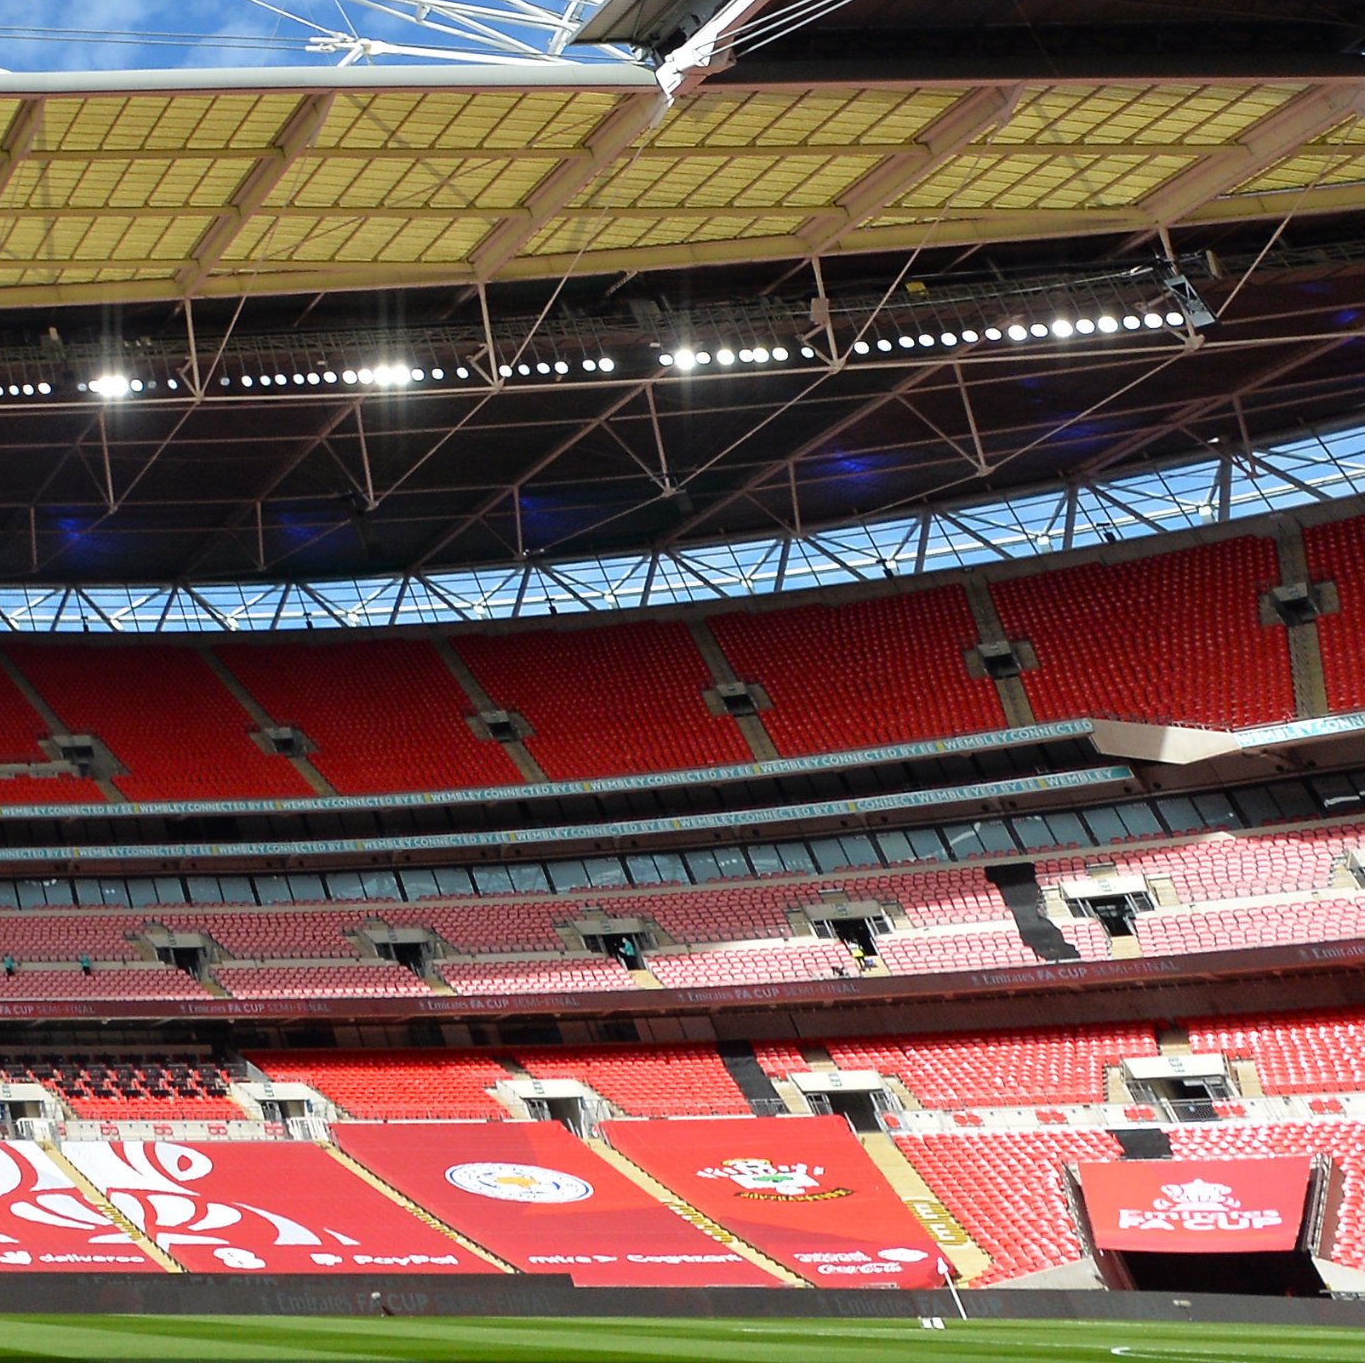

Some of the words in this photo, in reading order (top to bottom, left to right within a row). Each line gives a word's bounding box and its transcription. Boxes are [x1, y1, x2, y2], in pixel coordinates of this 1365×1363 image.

[944, 733, 1006, 751] WEMBLEY
[1011, 721, 1091, 742] CONNECTED
[761, 757, 819, 774] WEMBLEY
[822, 748, 895, 767] CONNECTED
[901, 745, 916, 757] BY
[920, 743, 934, 754] EE
[591, 776, 644, 791] WEMBLEY
[647, 769, 716, 785] CONNECTED
[719, 767, 733, 778] BY
[739, 765, 750, 776] EE
[1049, 770, 1111, 788] WEMBLEY
[431, 790, 482, 803] WEMBLEY
[484, 785, 549, 799] CONNECTED
[552, 783, 565, 794] BY
[569, 782, 582, 792] EE
[857, 795, 917, 811] CONNECT
[1002, 782, 1018, 794] BY
[1022, 780, 1035, 792] EE
[681, 814, 735, 829] WEMBLEY
[739, 806, 809, 823] CONNECTED
[815, 804, 832, 816] BY
[835, 803, 846, 814] EE
[983, 971, 1034, 985] Emirates
[1036, 969, 1053, 981] FA
[1058, 967, 1087, 980] CUP
[427, 999, 468, 1009] Emirates
[469, 999, 483, 1009] FA
[486, 998, 509, 1008] CUP
[512, 997, 581, 1008] SEMI-FINAL
[687, 990, 733, 1002] Emirates
[735, 989, 749, 1000] FA
[753, 987, 779, 999] CUP
[0, 1005, 11, 1014] FA
[13, 1005, 34, 1014] CUP
[187, 1003, 226, 1013] Emirates
[227, 1003, 241, 1013] FA
[243, 1003, 265, 1013] CUP
[1118, 1209, 1282, 1220] Emirates
[1118, 1217, 1175, 1231] FA
[1181, 1217, 1283, 1231] CUP
[38, 1254, 146, 1263] deliveroo
[353, 1254, 459, 1266] PayPal
[386, 1296, 429, 1314] CUP
